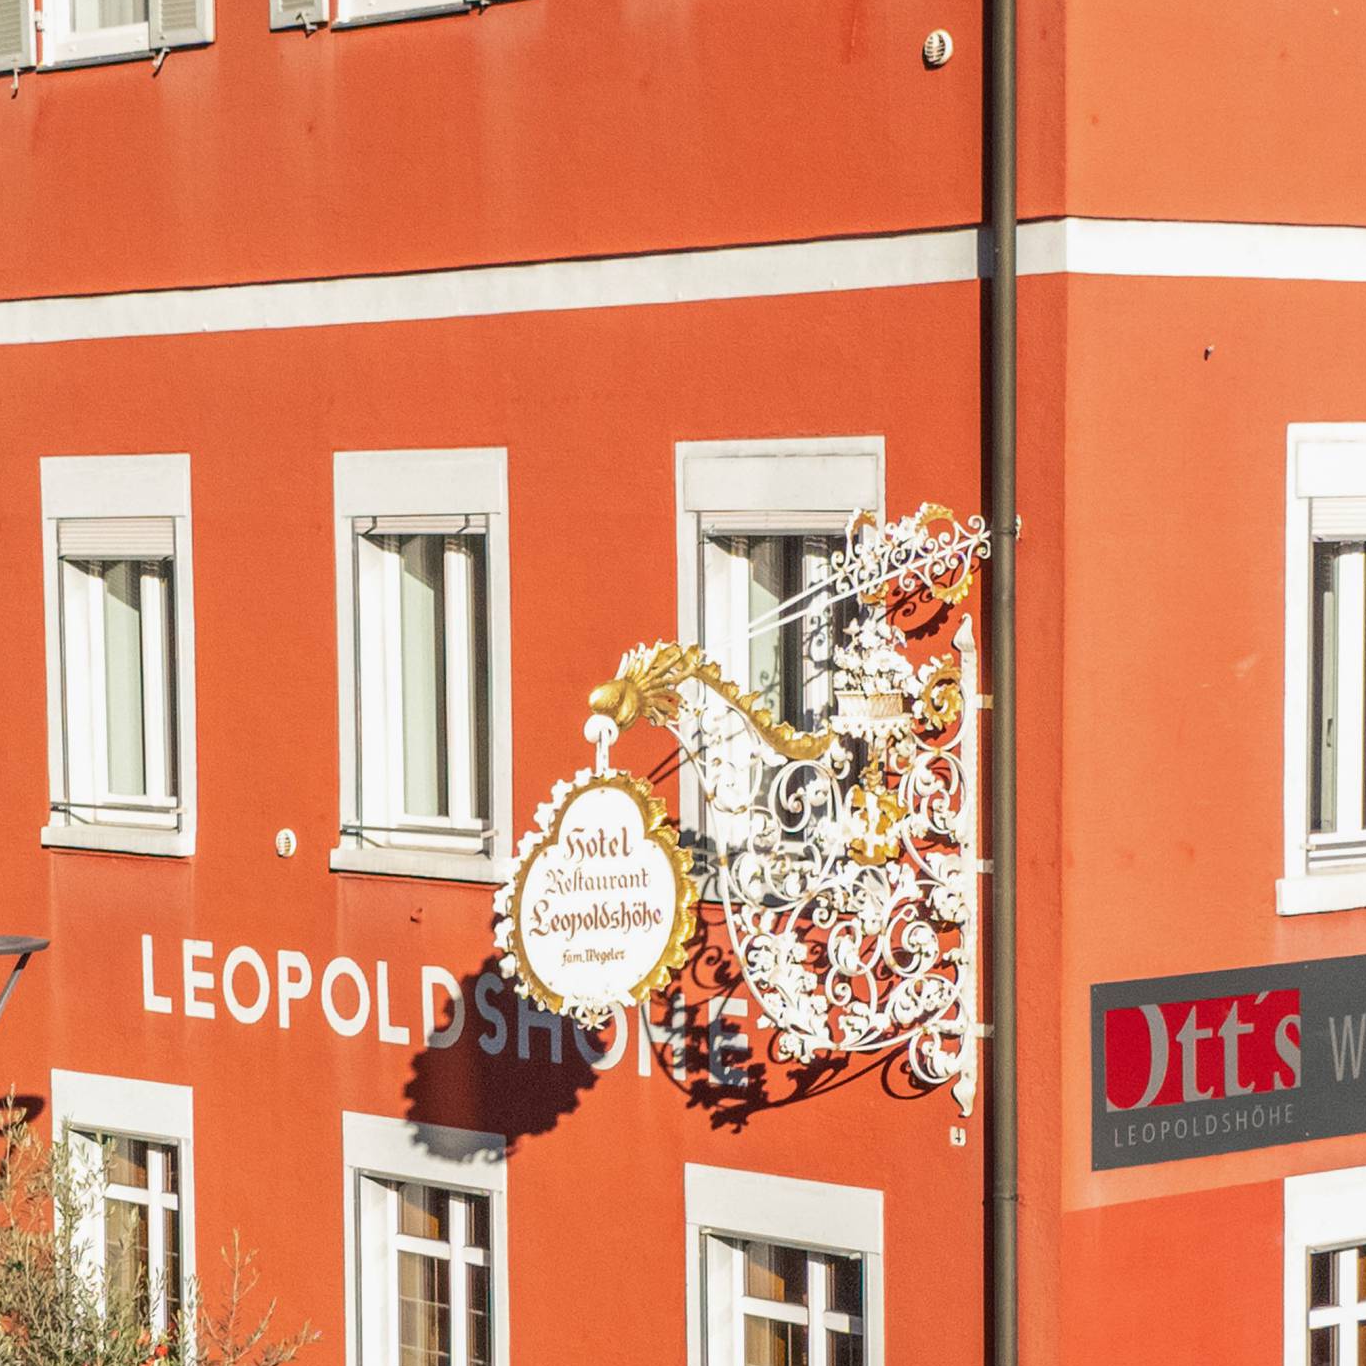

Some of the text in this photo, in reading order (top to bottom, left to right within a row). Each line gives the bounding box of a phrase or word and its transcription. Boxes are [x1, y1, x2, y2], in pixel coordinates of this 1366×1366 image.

[564, 826, 633, 863] Hotel
[529, 899, 663, 942] Leopoldshöhe
[1115, 1103, 1294, 1149] LEOPOLDSHÖHE
